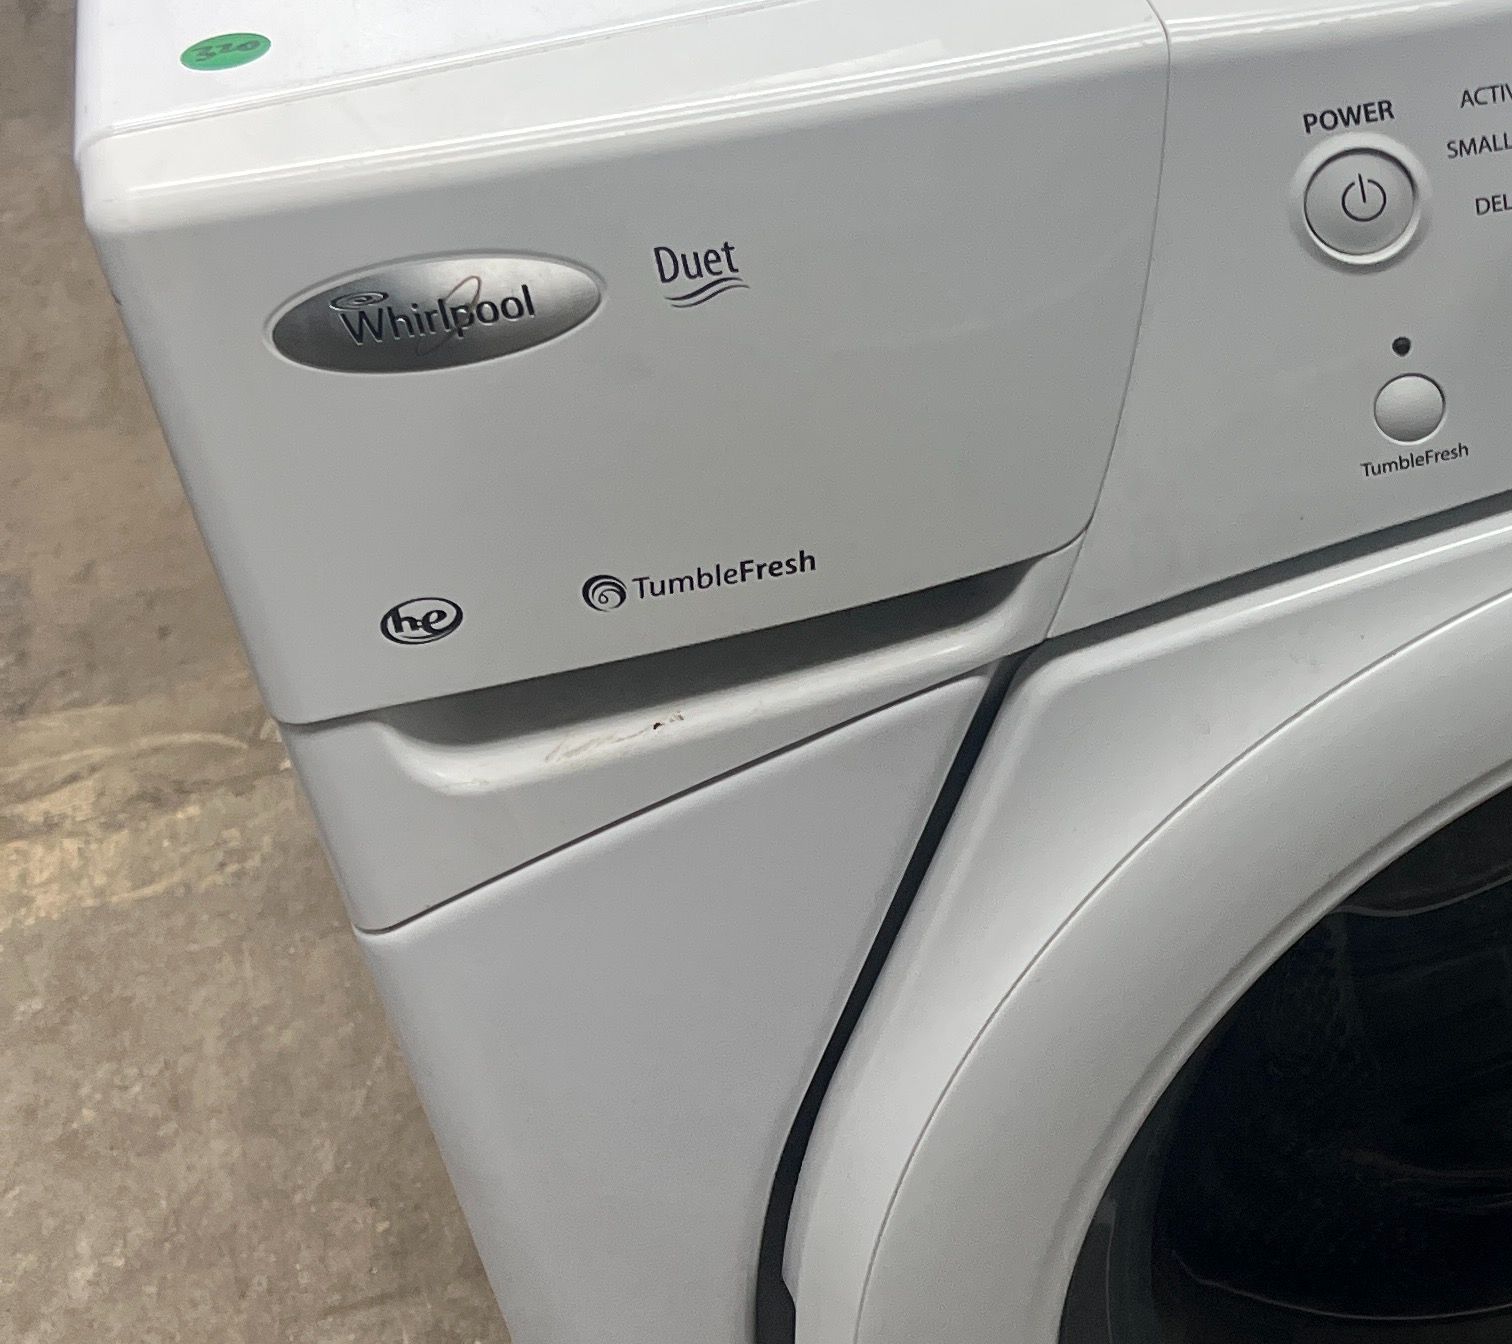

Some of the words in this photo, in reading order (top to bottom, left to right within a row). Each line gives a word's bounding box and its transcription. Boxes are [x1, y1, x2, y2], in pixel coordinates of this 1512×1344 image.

[1303, 99, 1396, 134] POWER
[653, 240, 739, 284] Duet
[340, 284, 536, 347] Whirlpool
[1361, 442, 1469, 478] TumbleFresh
[632, 550, 817, 600] TumbleFresh
